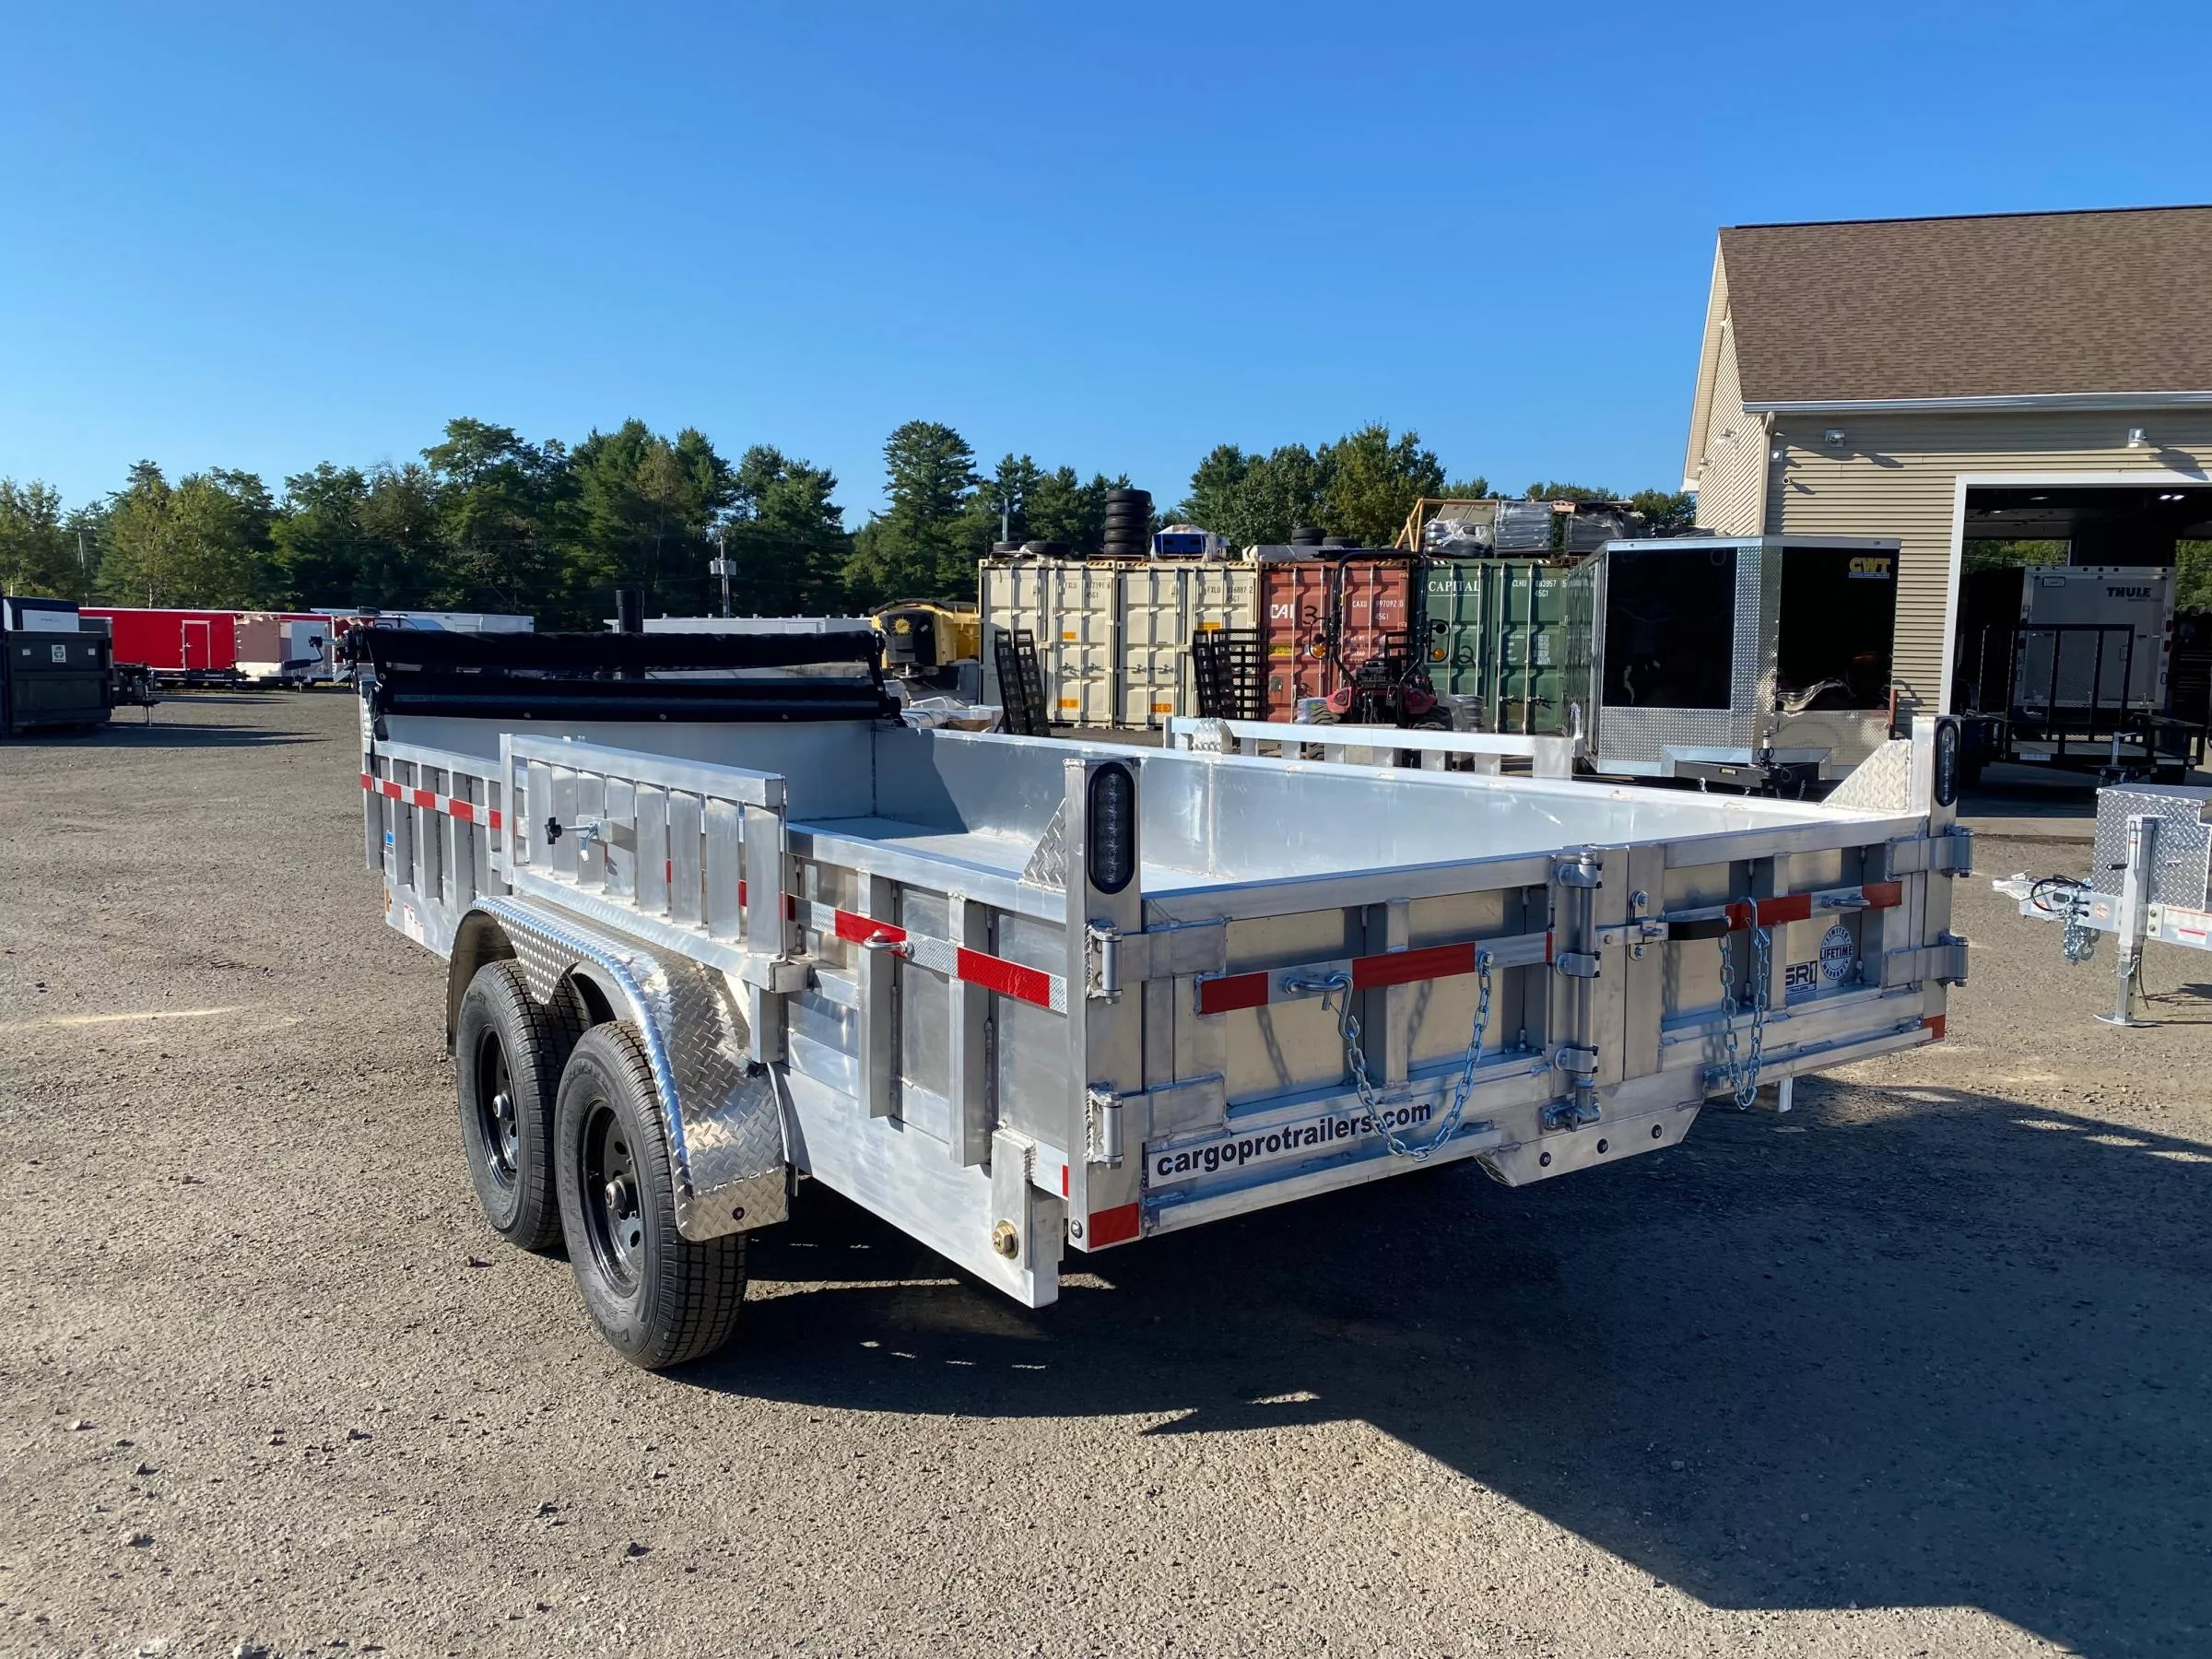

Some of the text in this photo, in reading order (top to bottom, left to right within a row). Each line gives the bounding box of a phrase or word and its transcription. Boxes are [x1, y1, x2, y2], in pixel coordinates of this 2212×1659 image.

[1849, 557, 1890, 573] CWT
[1206, 585, 1221, 594] FXLU
[1429, 580, 1480, 592] CAPITAL
[1512, 579, 1527, 588] CLHU
[1535, 579, 1557, 588] 883957
[1535, 589, 1549, 597] 45G1
[2106, 586, 2152, 598] THULE
[1352, 600, 1368, 608] CAXU
[1375, 600, 1397, 608] 997092
[1302, 605, 1318, 625] 3
[1375, 612, 1389, 620] 45G1
[1458, 645, 1476, 665] 2
[1825, 927, 1849, 942] LIMITED
[1819, 945, 1853, 960] LIFETIME
[1822, 959, 1850, 978] WARRANTY
[1157, 1102, 1431, 1176] cargoprotrailers.com
